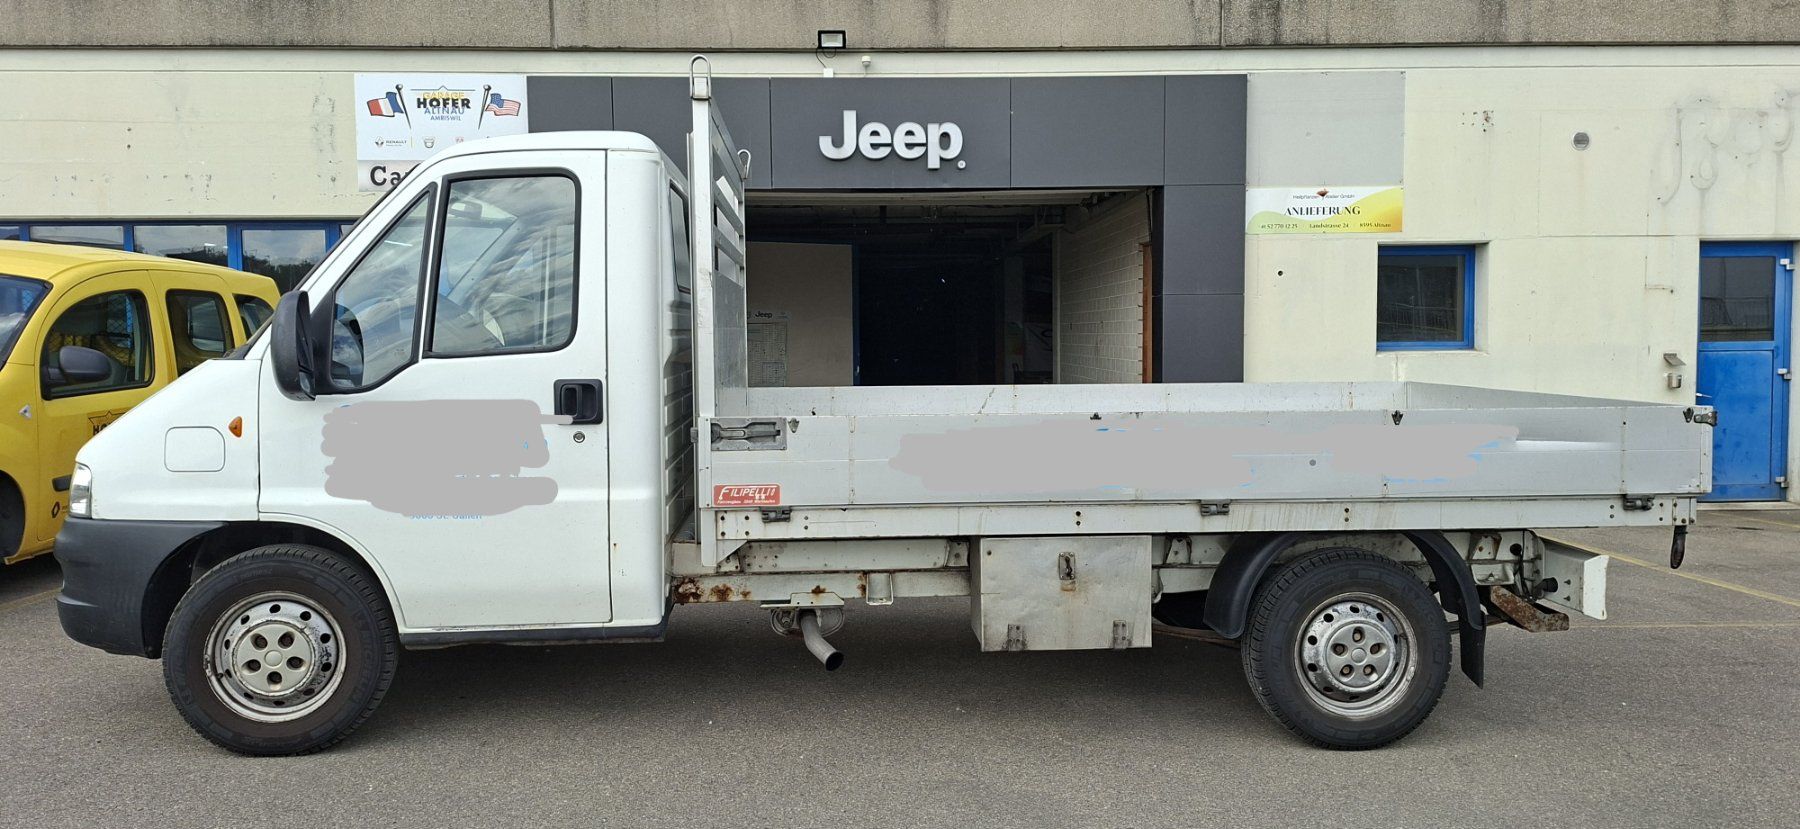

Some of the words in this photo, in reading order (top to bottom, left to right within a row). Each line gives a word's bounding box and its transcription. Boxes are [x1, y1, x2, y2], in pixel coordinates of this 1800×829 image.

[416, 98, 471, 109] HOFER
[424, 107, 465, 115] ALTNAU
[818, 109, 964, 169] Jeep
[1284, 206, 1361, 216] ANLIEFERUNG
[754, 310, 773, 319] Jeep
